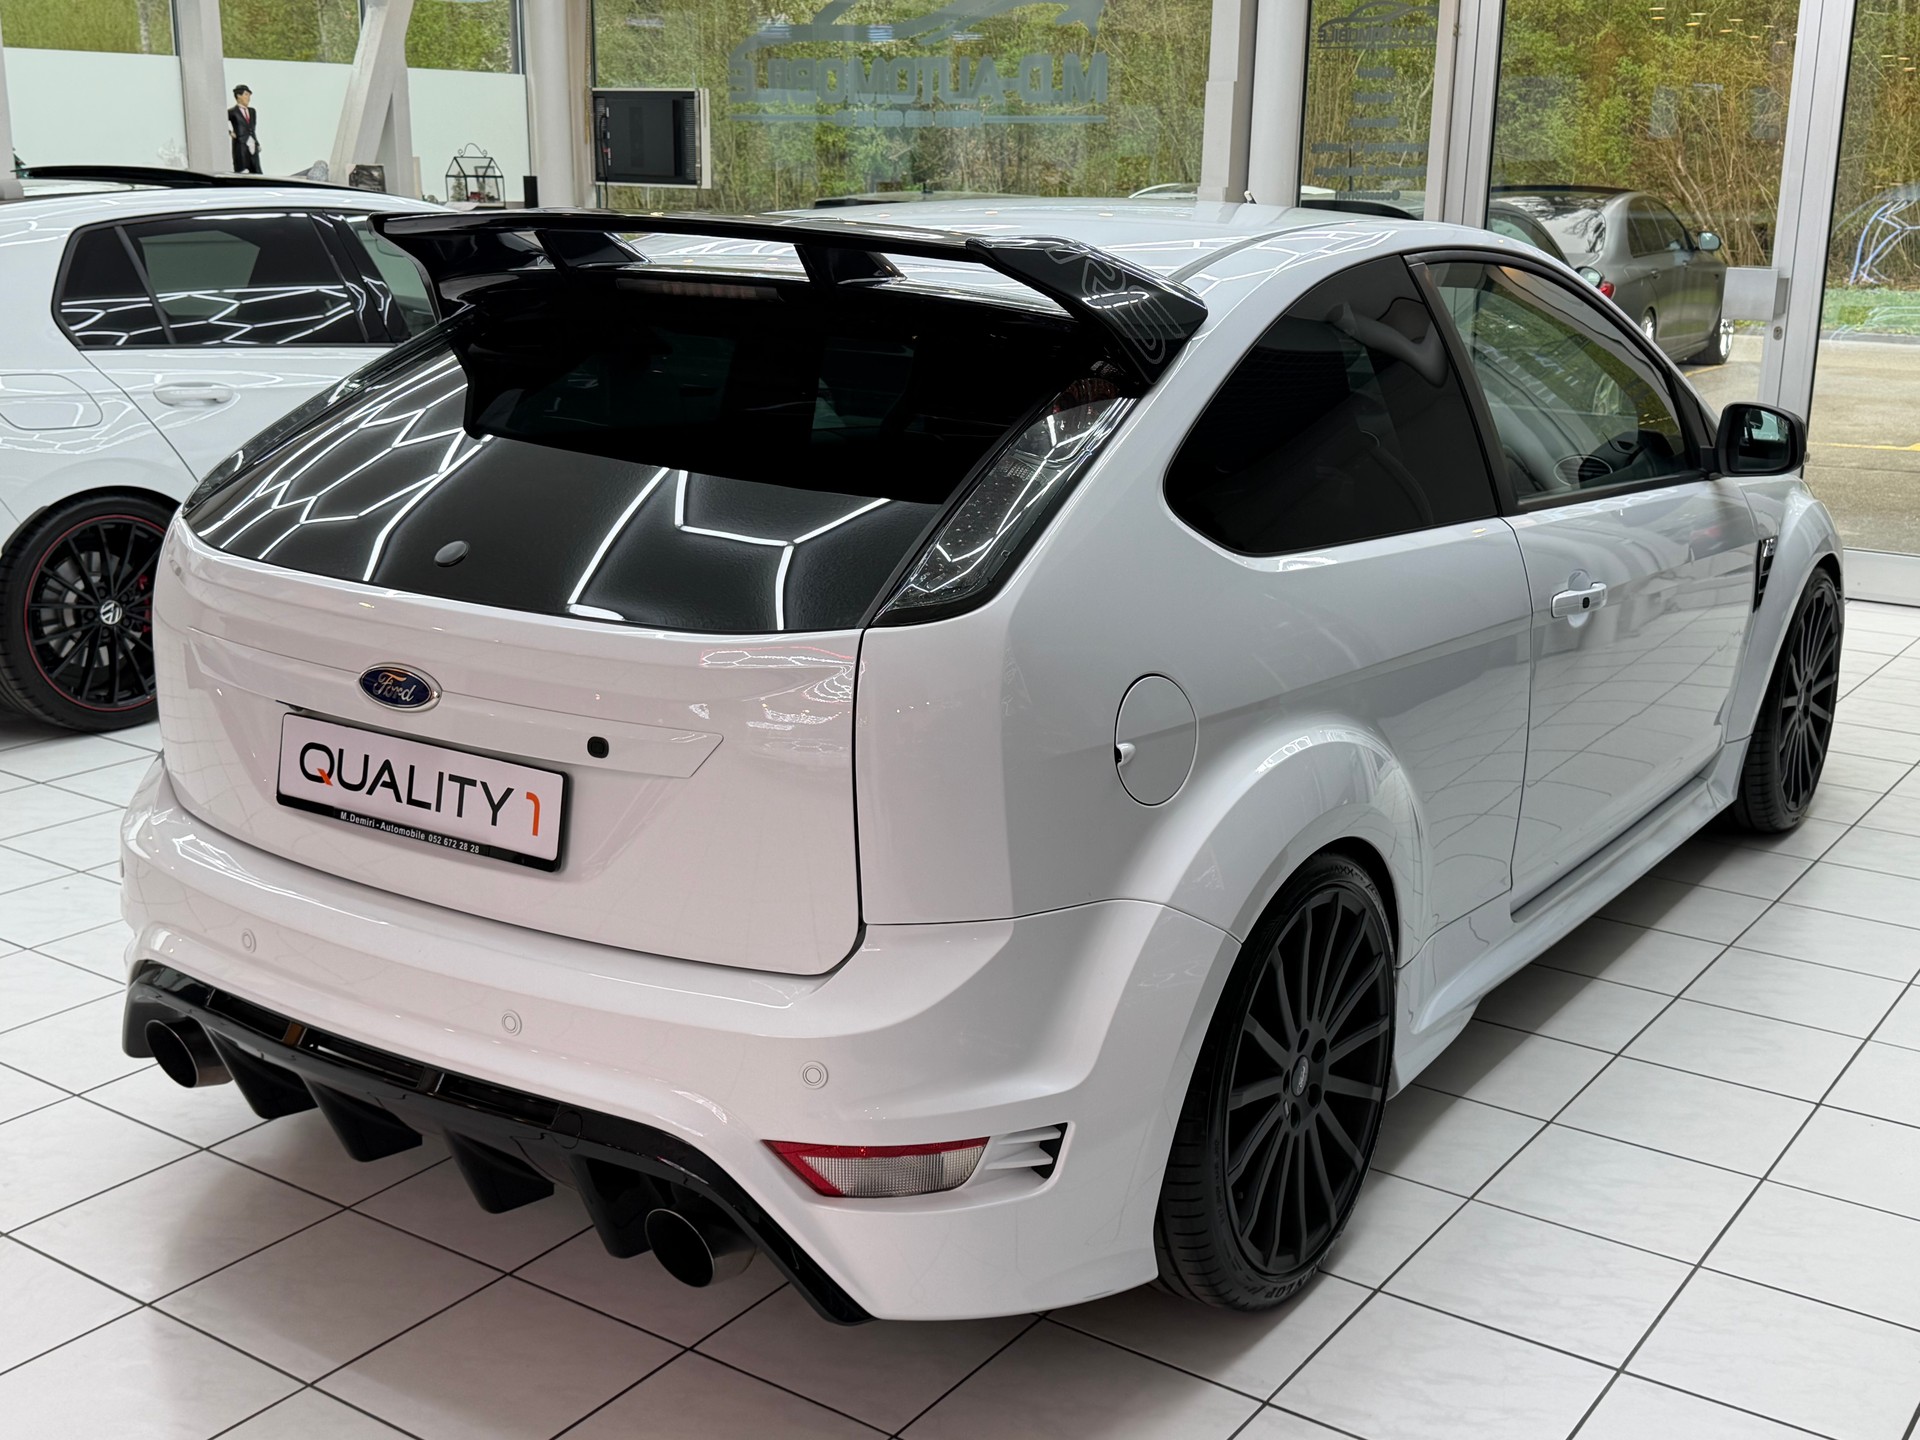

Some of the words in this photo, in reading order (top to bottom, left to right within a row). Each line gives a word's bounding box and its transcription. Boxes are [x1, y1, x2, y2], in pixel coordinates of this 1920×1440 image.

[373, 671, 417, 702] Ford
[428, 833, 441, 845] 052
[443, 837, 457, 849] 672
[459, 841, 468, 851] 28
[470, 844, 480, 854] 28
